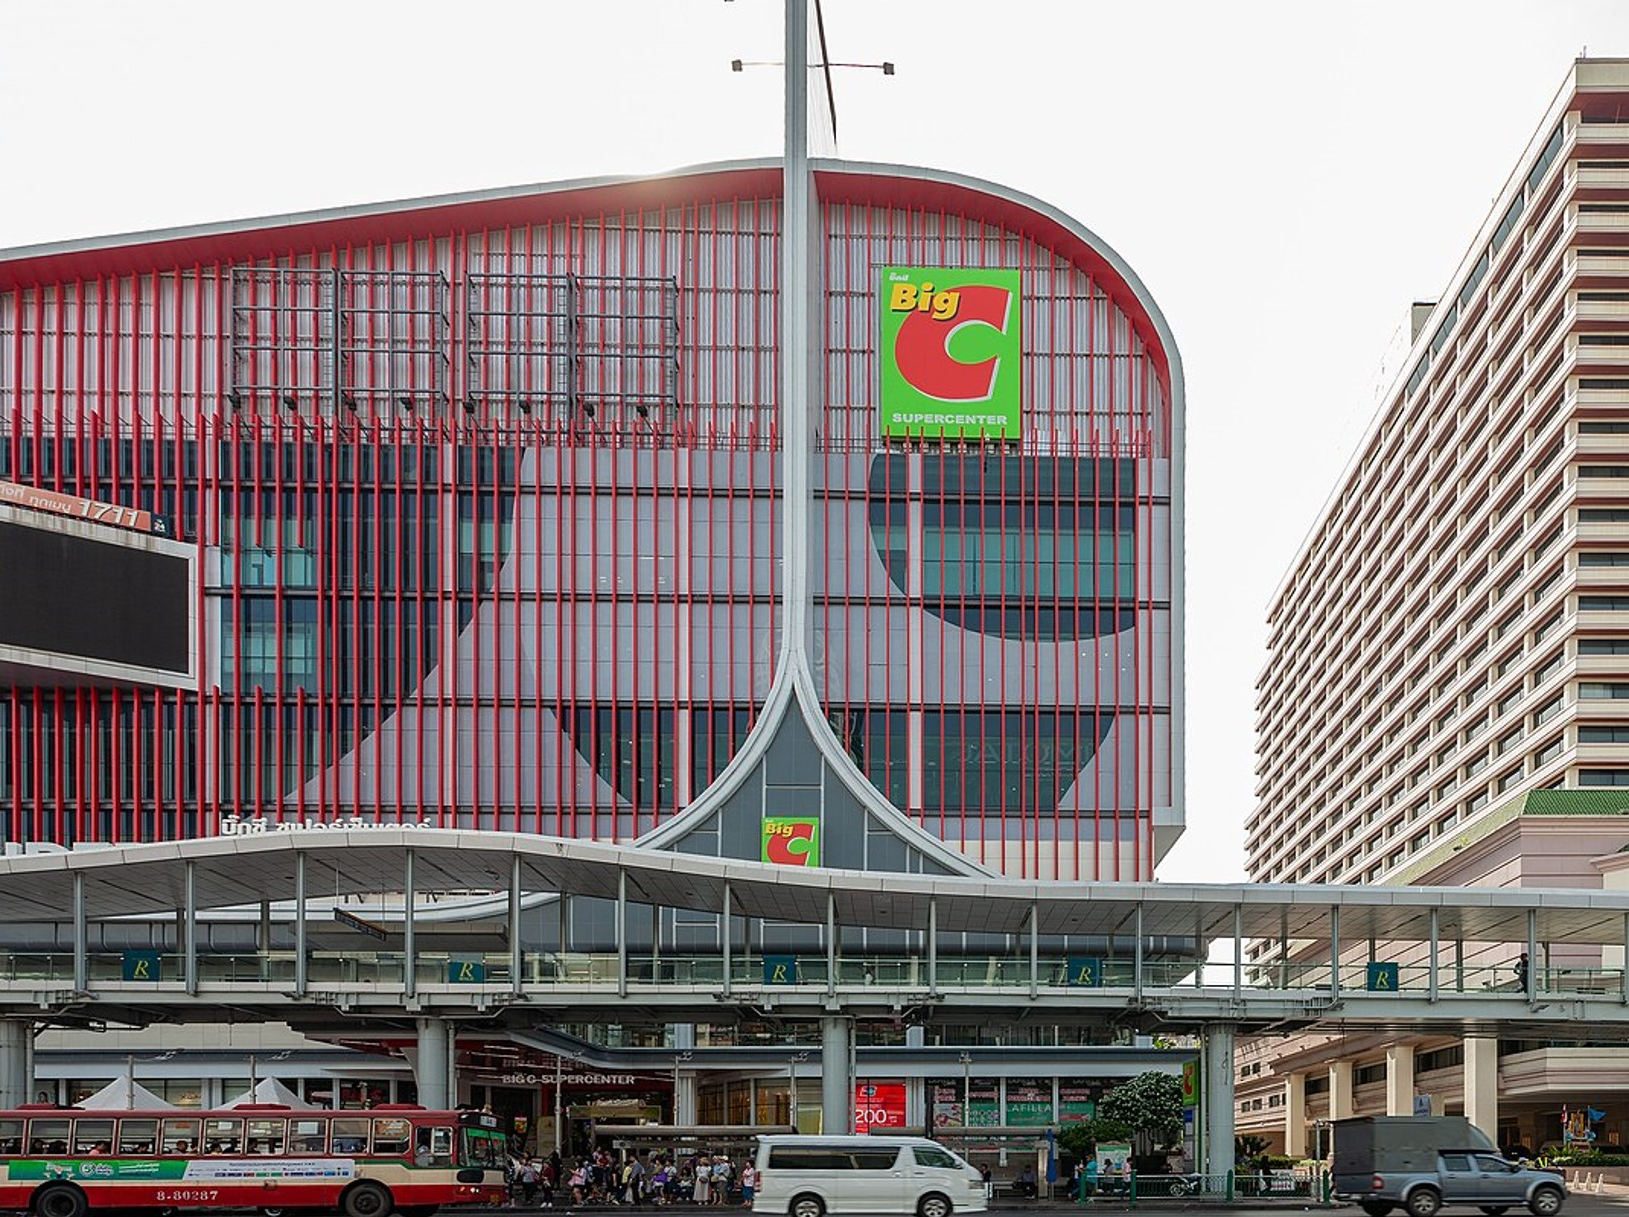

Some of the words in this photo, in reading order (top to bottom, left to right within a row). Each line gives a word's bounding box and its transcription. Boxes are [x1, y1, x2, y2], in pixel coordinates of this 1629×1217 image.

[889, 282, 961, 321] Big
[895, 284, 1013, 402] C
[892, 413, 1008, 425] SUPERCENTER
[79, 499, 139, 527] 1711
[765, 822, 794, 838] Big
[766, 822, 816, 866] C
[134, 960, 149, 976] R
[459, 961, 474, 977] R
[772, 964, 787, 982] R
[1077, 967, 1091, 982] R
[1375, 970, 1389, 987] R
[541, 1074, 636, 1085] SUPERCENTER
[855, 1109, 887, 1124] 200
